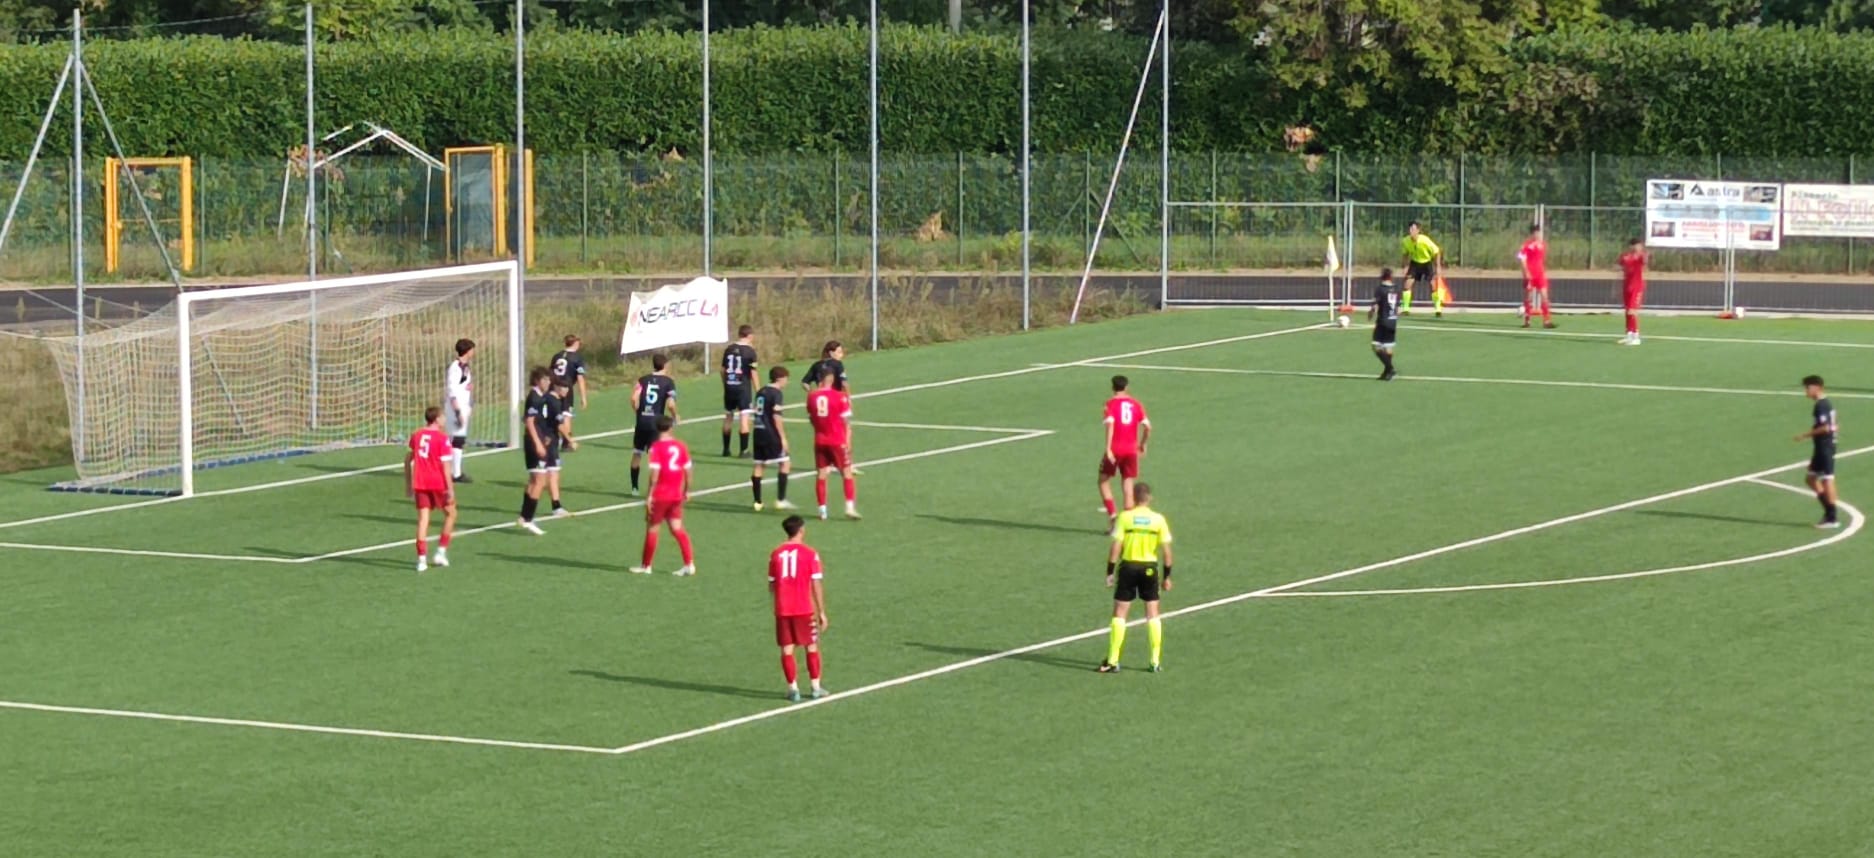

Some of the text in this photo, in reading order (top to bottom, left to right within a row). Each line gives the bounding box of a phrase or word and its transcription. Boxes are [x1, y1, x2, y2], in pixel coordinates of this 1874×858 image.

[553, 358, 568, 376] 3
[726, 354, 743, 374] 11
[645, 384, 660, 404] 5
[1121, 401, 1134, 425] 6
[418, 434, 431, 459] 5
[668, 446, 680, 470] 2
[778, 549, 798, 579] 11
